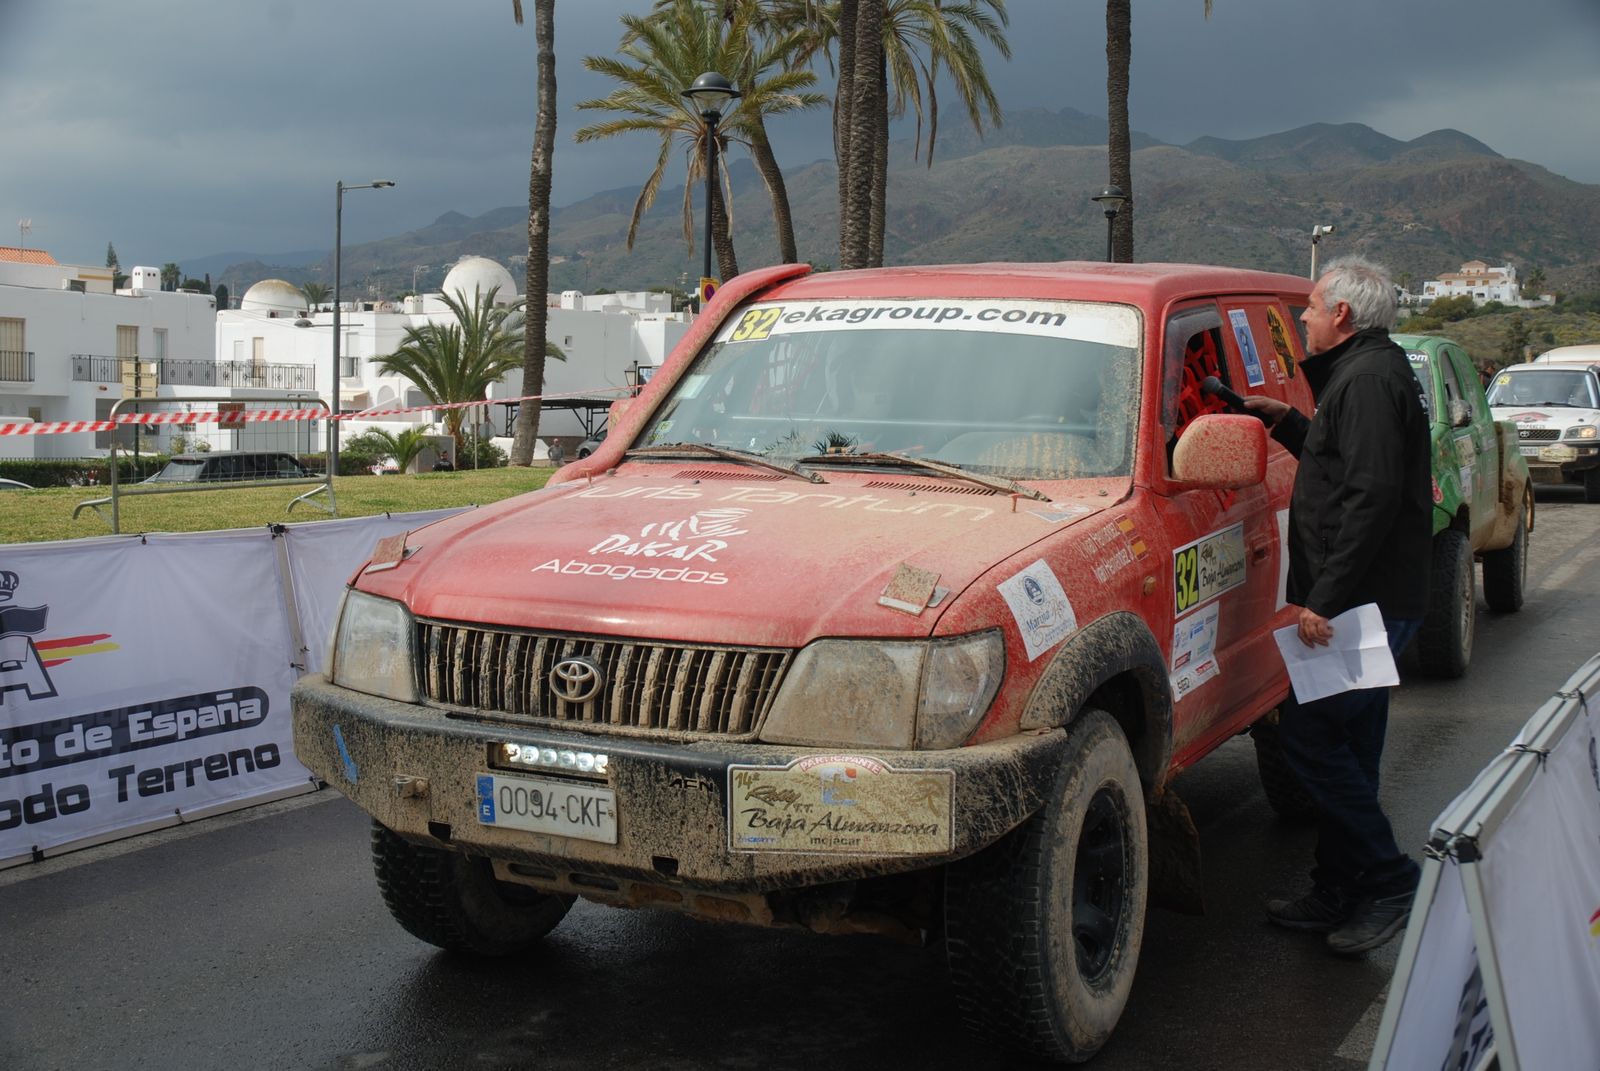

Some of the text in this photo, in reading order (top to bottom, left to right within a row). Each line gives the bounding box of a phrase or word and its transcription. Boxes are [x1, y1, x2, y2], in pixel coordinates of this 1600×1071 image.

[733, 308, 781, 341] 32
[780, 306, 1067, 327] ekagroup.com
[1406, 353, 1428, 362] om
[718, 487, 995, 522] Tantum
[588, 534, 728, 562] DAKAR
[531, 559, 729, 585] Abogados
[1176, 548, 1198, 610] 32
[54, 723, 113, 757] de
[128, 692, 262, 743] España
[108, 743, 281, 803] Terreno
[800, 755, 882, 776] PARTICIPANTE
[482, 804, 491, 816] E
[499, 786, 610, 828] 0094 CKF
[745, 785, 802, 811] Rally
[740, 807, 940, 838] Baja Almanzora
